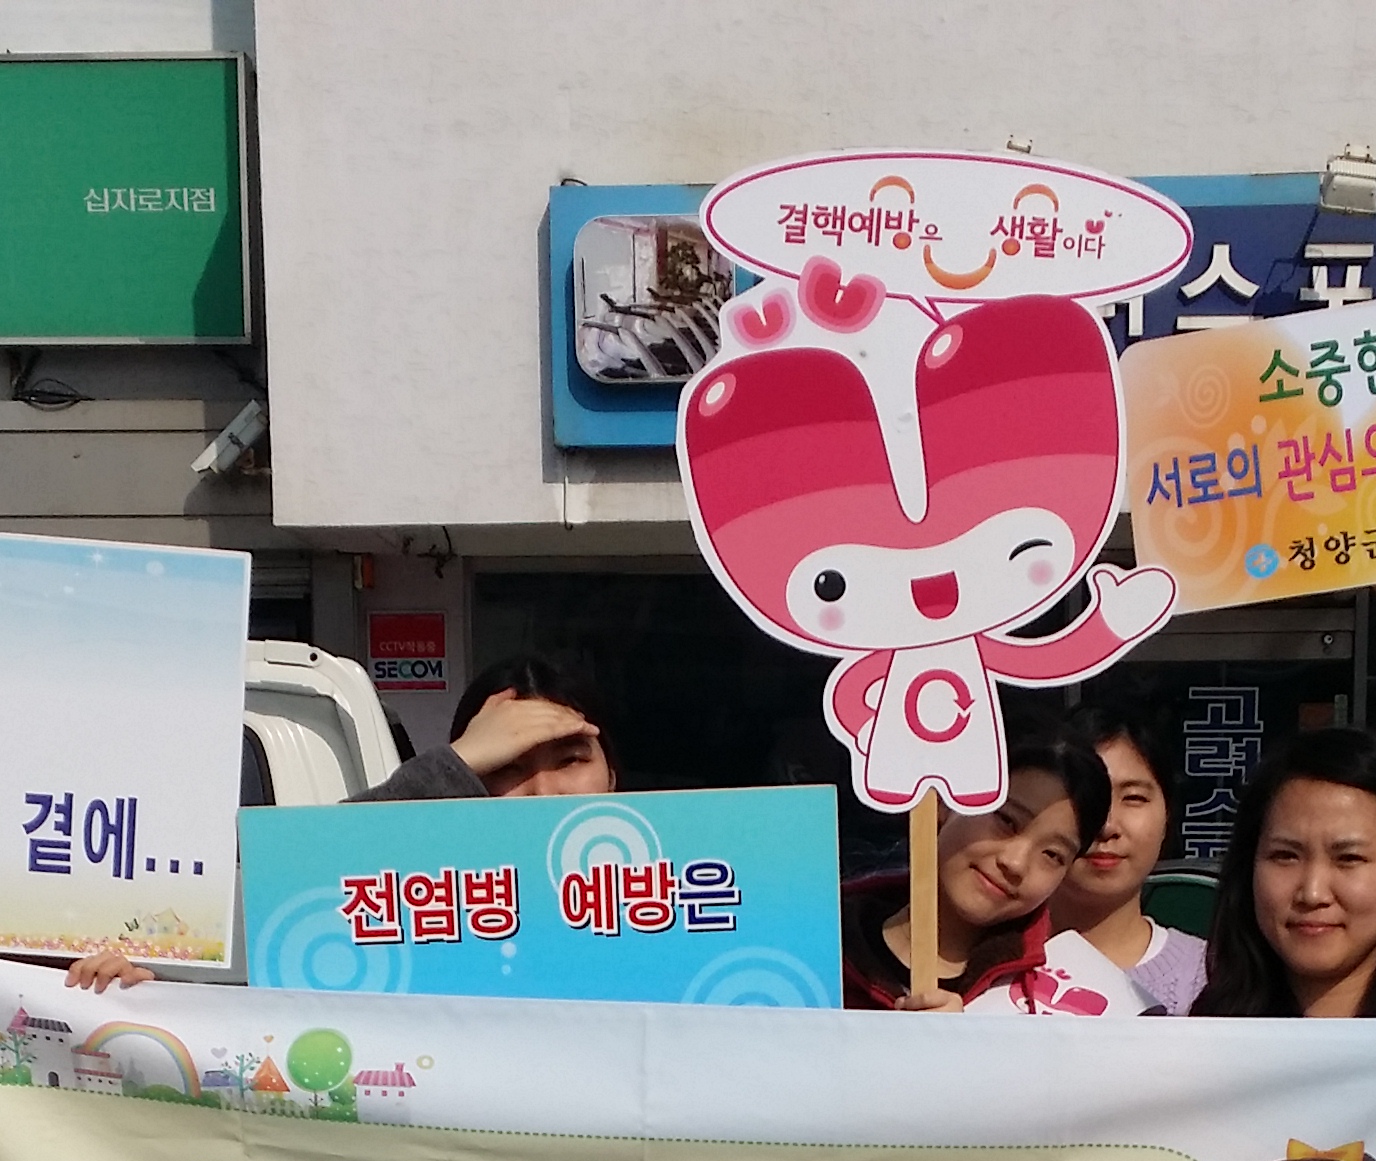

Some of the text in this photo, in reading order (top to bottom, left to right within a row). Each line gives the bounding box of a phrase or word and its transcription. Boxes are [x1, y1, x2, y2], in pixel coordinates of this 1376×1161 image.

[83, 185, 217, 214] 십자로지점
[989, 214, 1106, 259] 생활이다
[1145, 443, 1264, 508] 서로의
[374, 660, 443, 679] SECOM
[22, 789, 205, 881] 곁에...
[340, 859, 741, 945] 전염병 예방은
